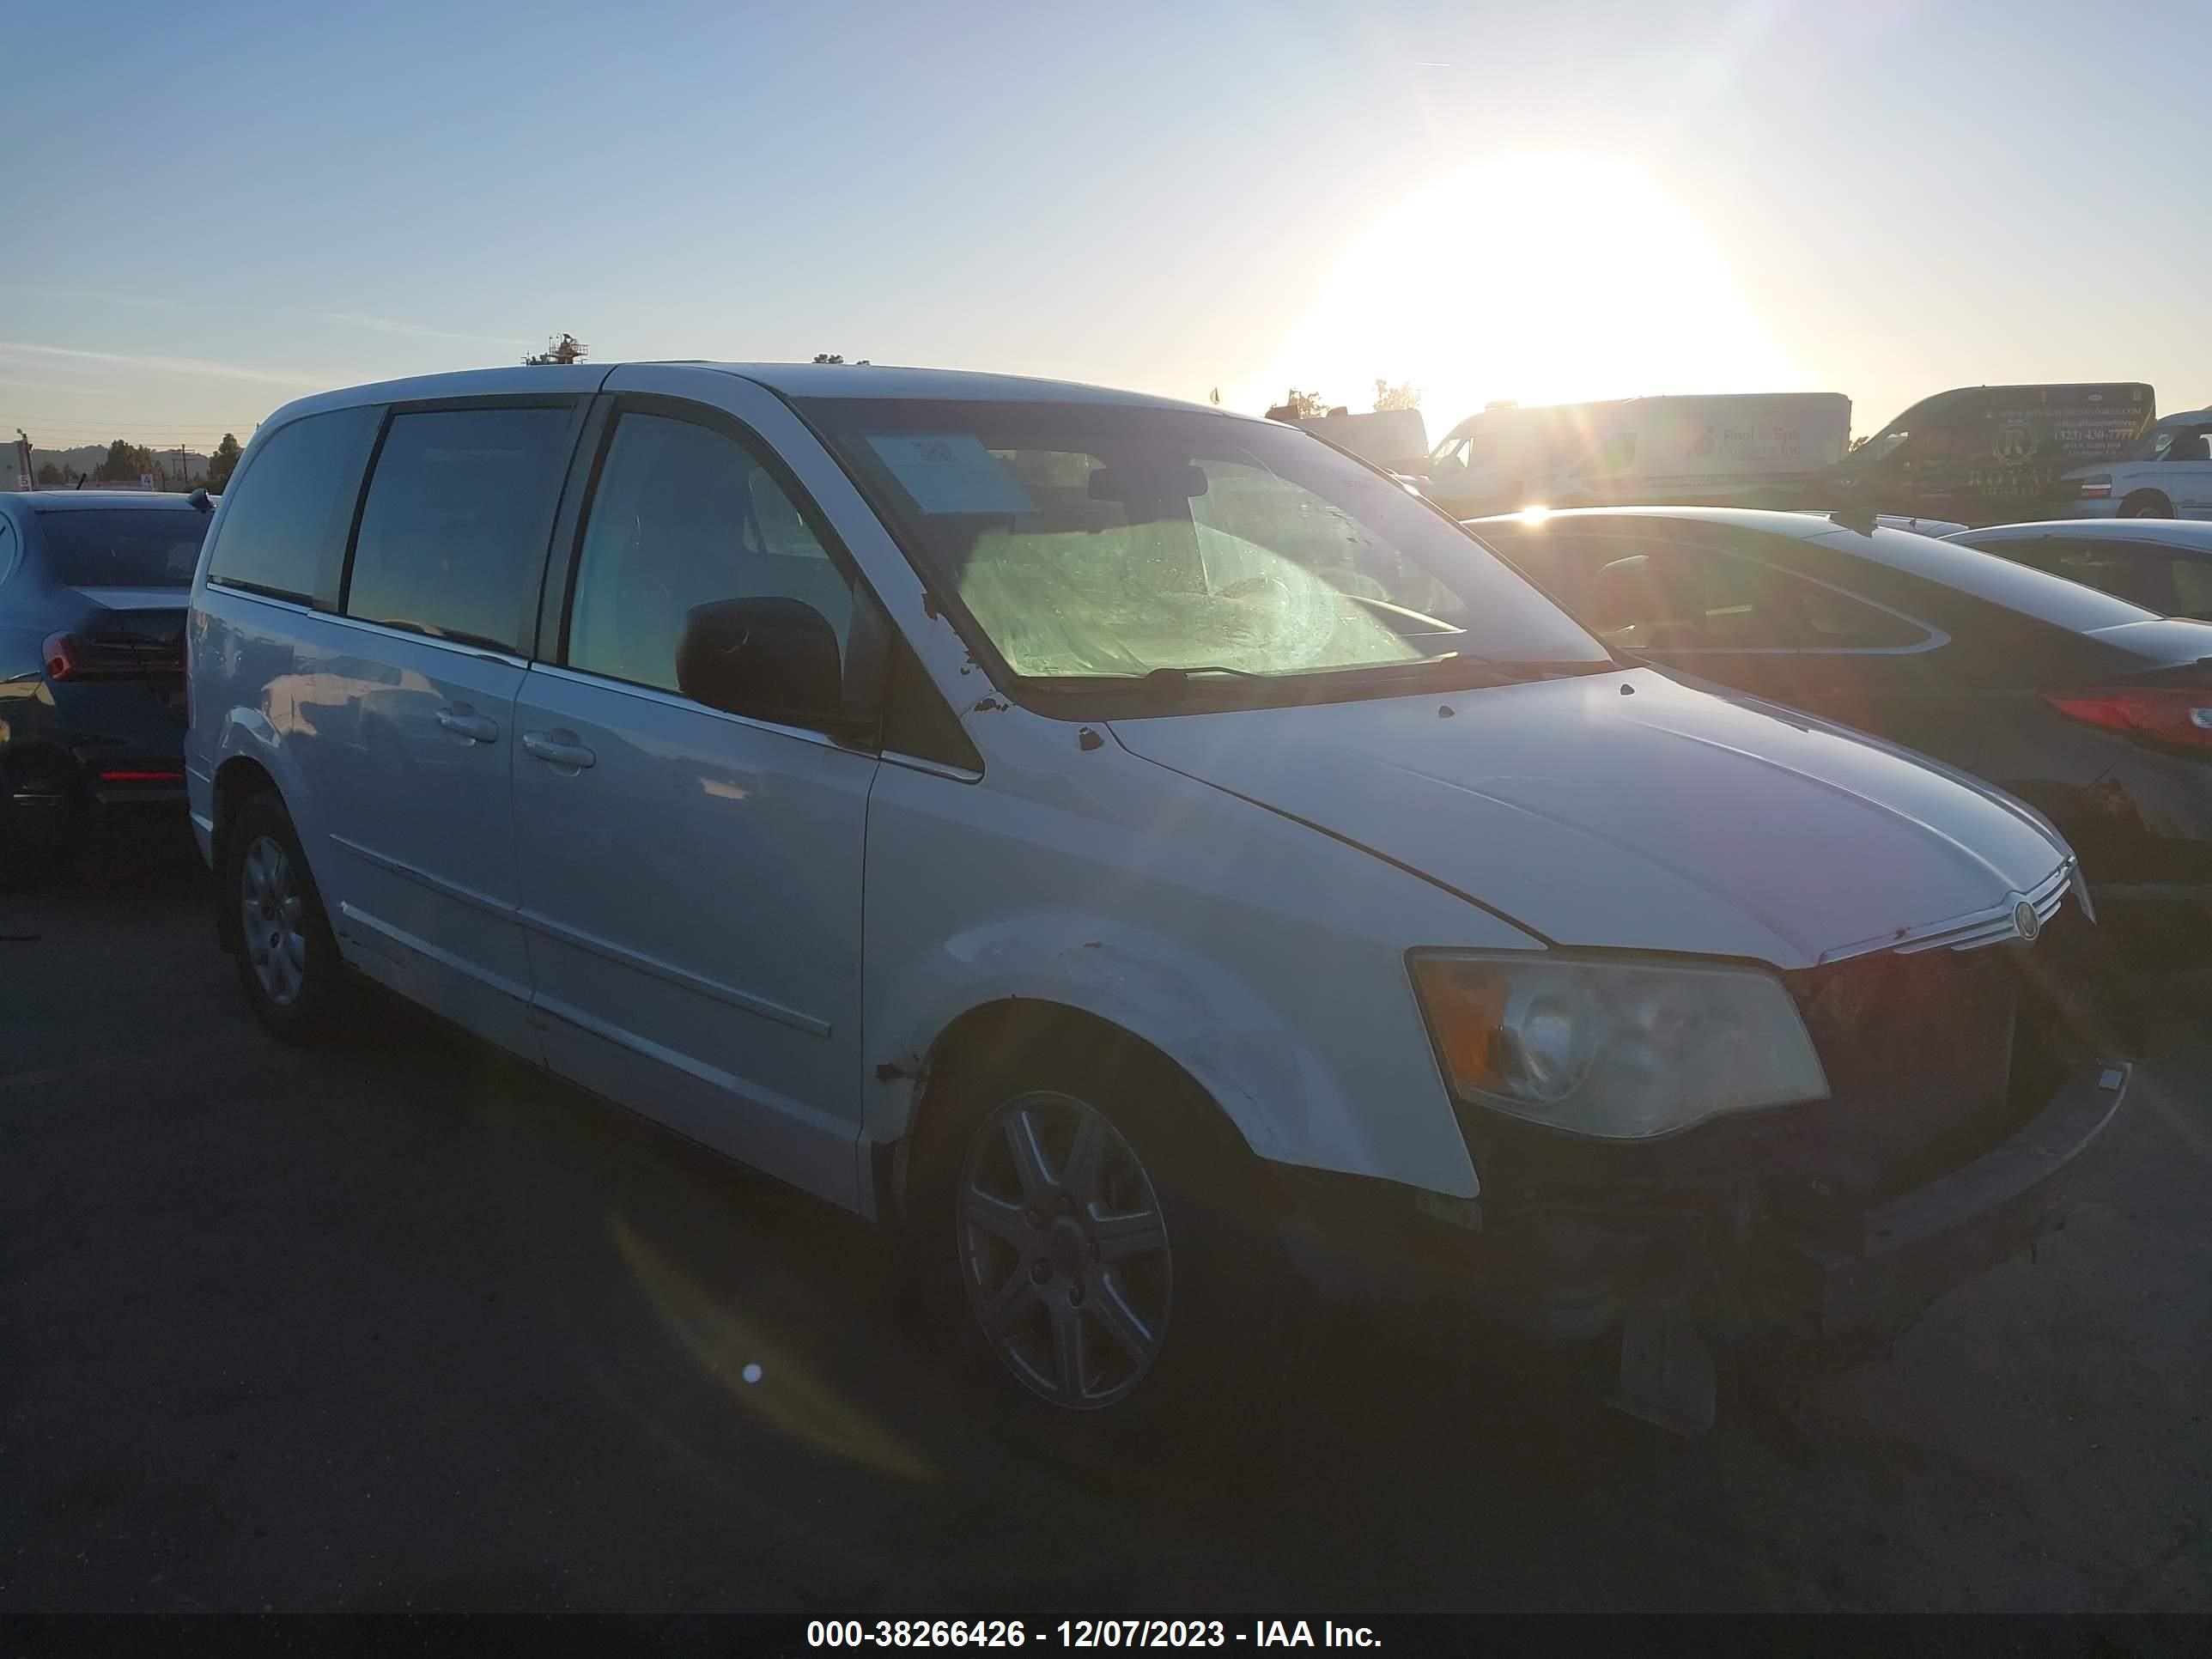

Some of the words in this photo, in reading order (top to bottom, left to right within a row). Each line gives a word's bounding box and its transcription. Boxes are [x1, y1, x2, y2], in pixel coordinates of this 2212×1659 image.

[1723, 427, 1754, 441] Pool
[1773, 427, 1801, 443] Spa
[2054, 429, 2082, 441] (323)
[2085, 428, 2134, 441] 430-7777
[21, 476, 28, 485] 5
[1967, 469, 2054, 486] ROYAL
